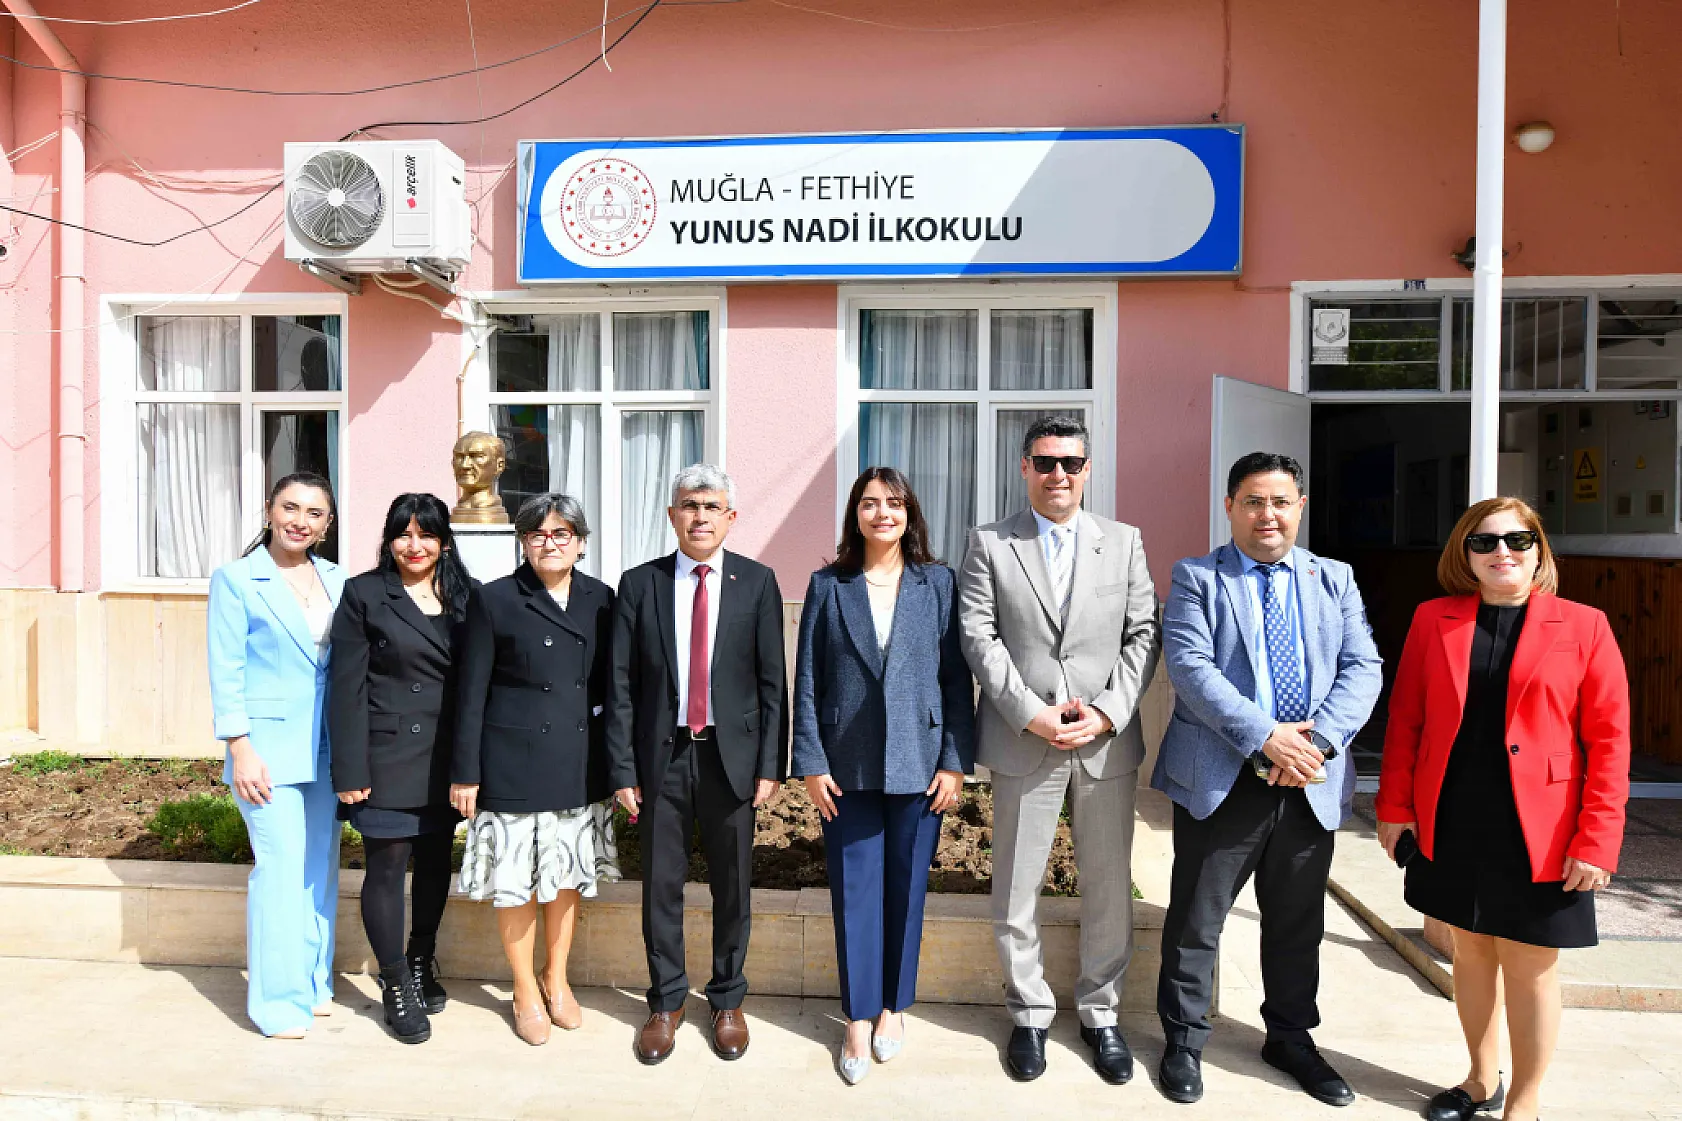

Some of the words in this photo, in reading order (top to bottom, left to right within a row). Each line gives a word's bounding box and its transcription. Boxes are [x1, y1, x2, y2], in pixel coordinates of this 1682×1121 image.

[405, 154, 418, 196] arçelik
[670, 172, 774, 203] MUĞLA
[801, 170, 915, 200] FETHİYE
[669, 219, 775, 244] YUNUS
[782, 211, 859, 243] NADİ
[868, 211, 1023, 243] İLKOKULU
